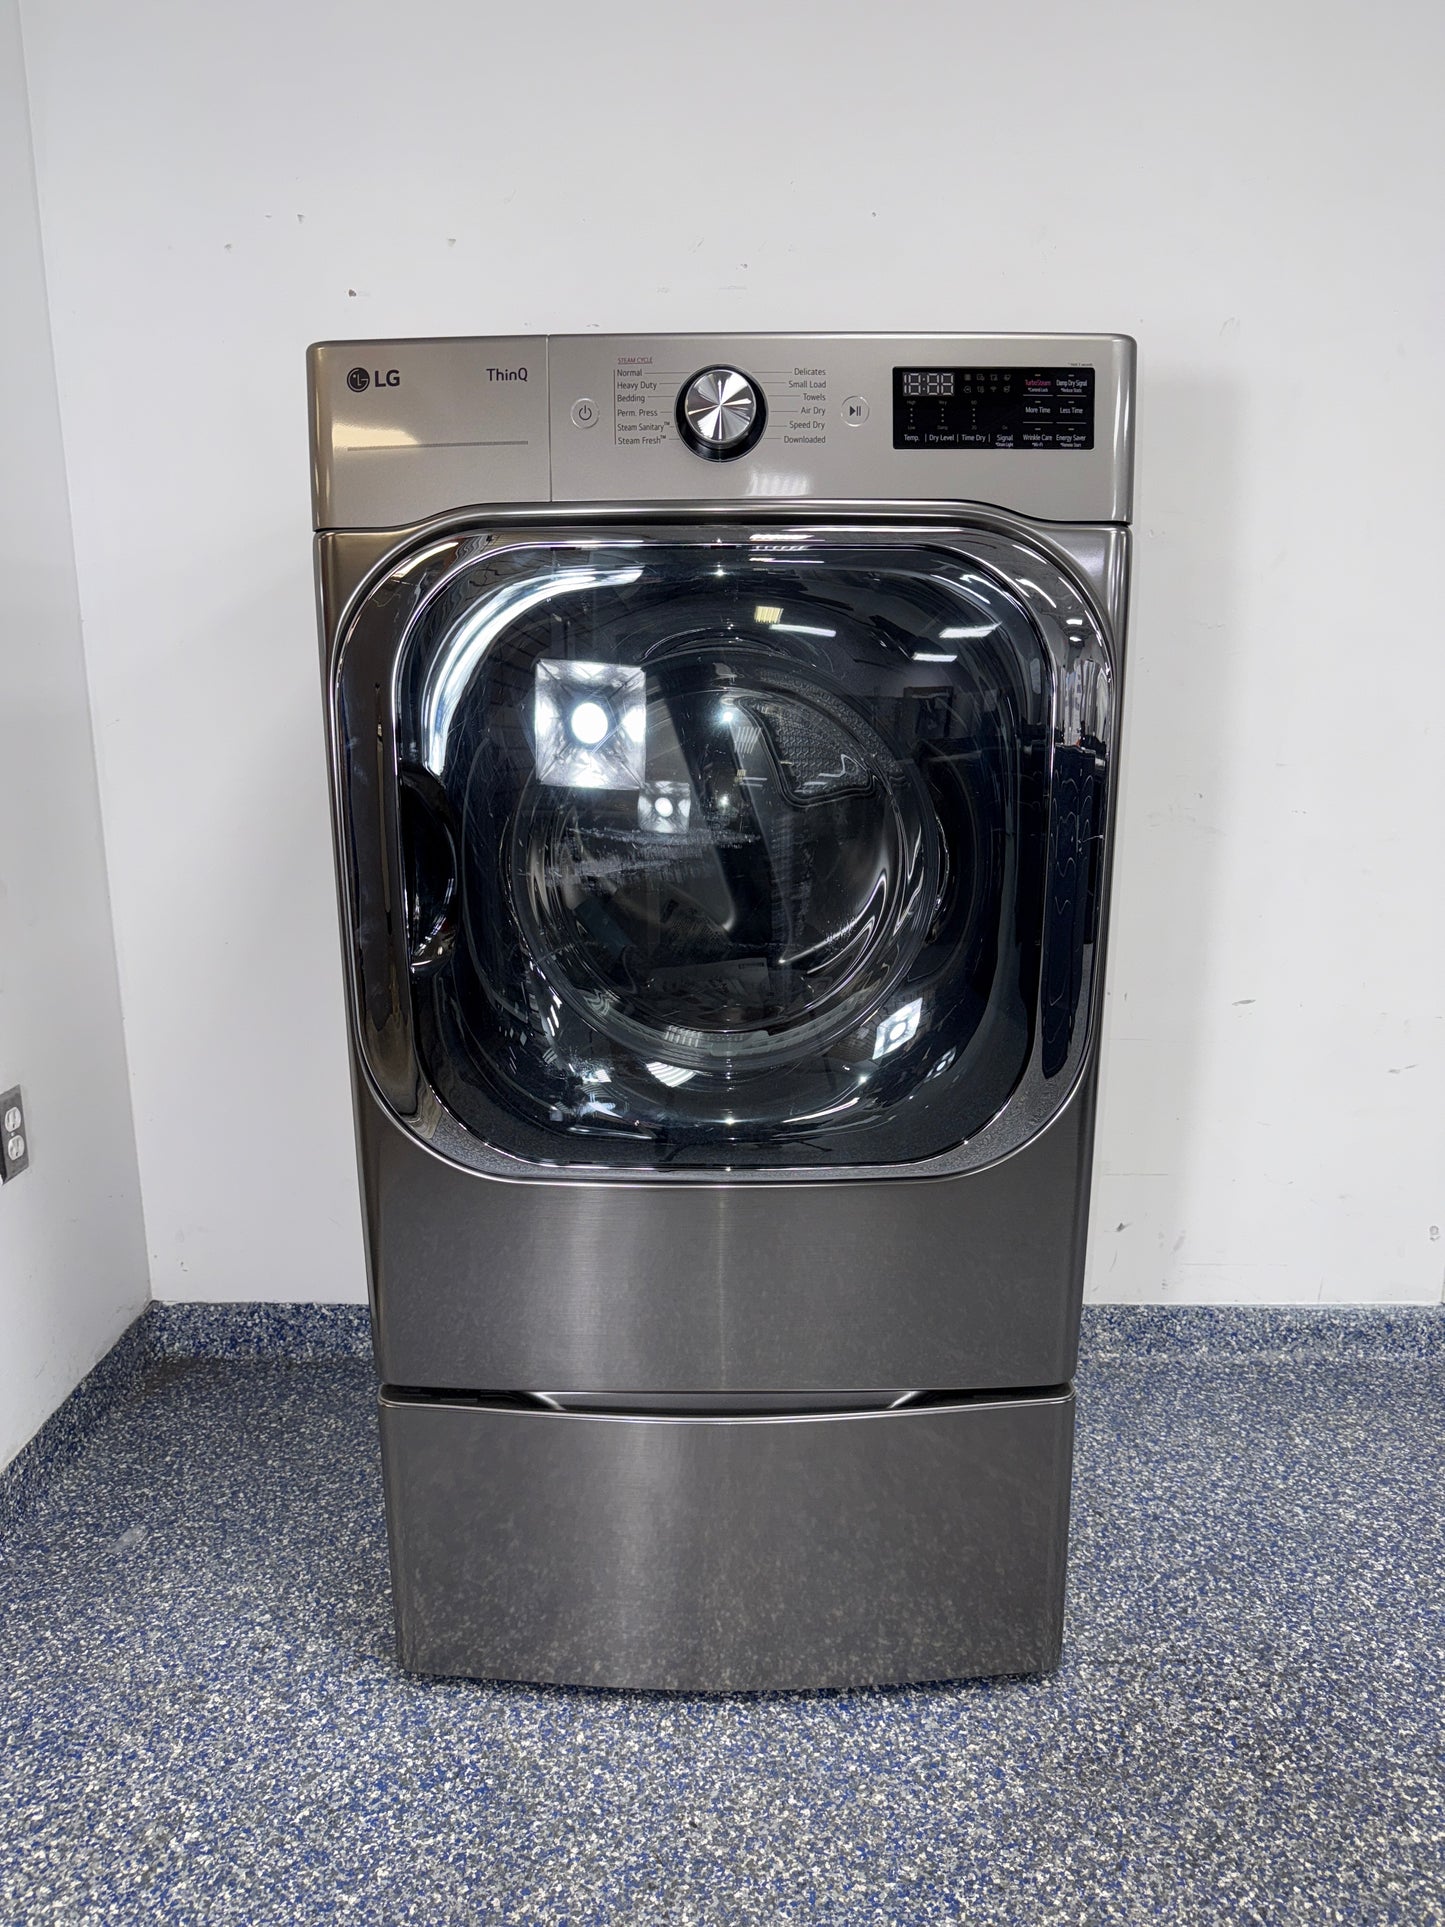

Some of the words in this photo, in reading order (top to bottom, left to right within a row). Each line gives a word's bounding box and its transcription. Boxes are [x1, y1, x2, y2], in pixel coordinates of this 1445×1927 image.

[486, 367, 529, 382] ThinQ
[616, 369, 643, 377] Normal
[794, 367, 826, 376] Delicates
[374, 369, 401, 388] LG
[1068, 379, 1076, 387] Dry
[1076, 379, 1087, 387] Signal
[616, 381, 639, 391] Heavy
[640, 381, 658, 391] Duty
[788, 380, 808, 388] Small
[809, 380, 826, 388] Load
[616, 394, 646, 404] Bedding
[802, 392, 826, 401] Towels
[617, 409, 637, 417] Perm.
[638, 409, 658, 417] Press
[800, 406, 811, 414] Air
[813, 406, 826, 416] Dry
[617, 423, 638, 432] Steam
[789, 421, 811, 430] Speed
[812, 421, 826, 430] Dry
[617, 437, 640, 445] Steam
[783, 435, 826, 444] Downloaded
[928, 434, 940, 443] Dry
[975, 434, 986, 443] Dry
[996, 434, 1014, 442] Signal
[1055, 434, 1072, 442] Energy
